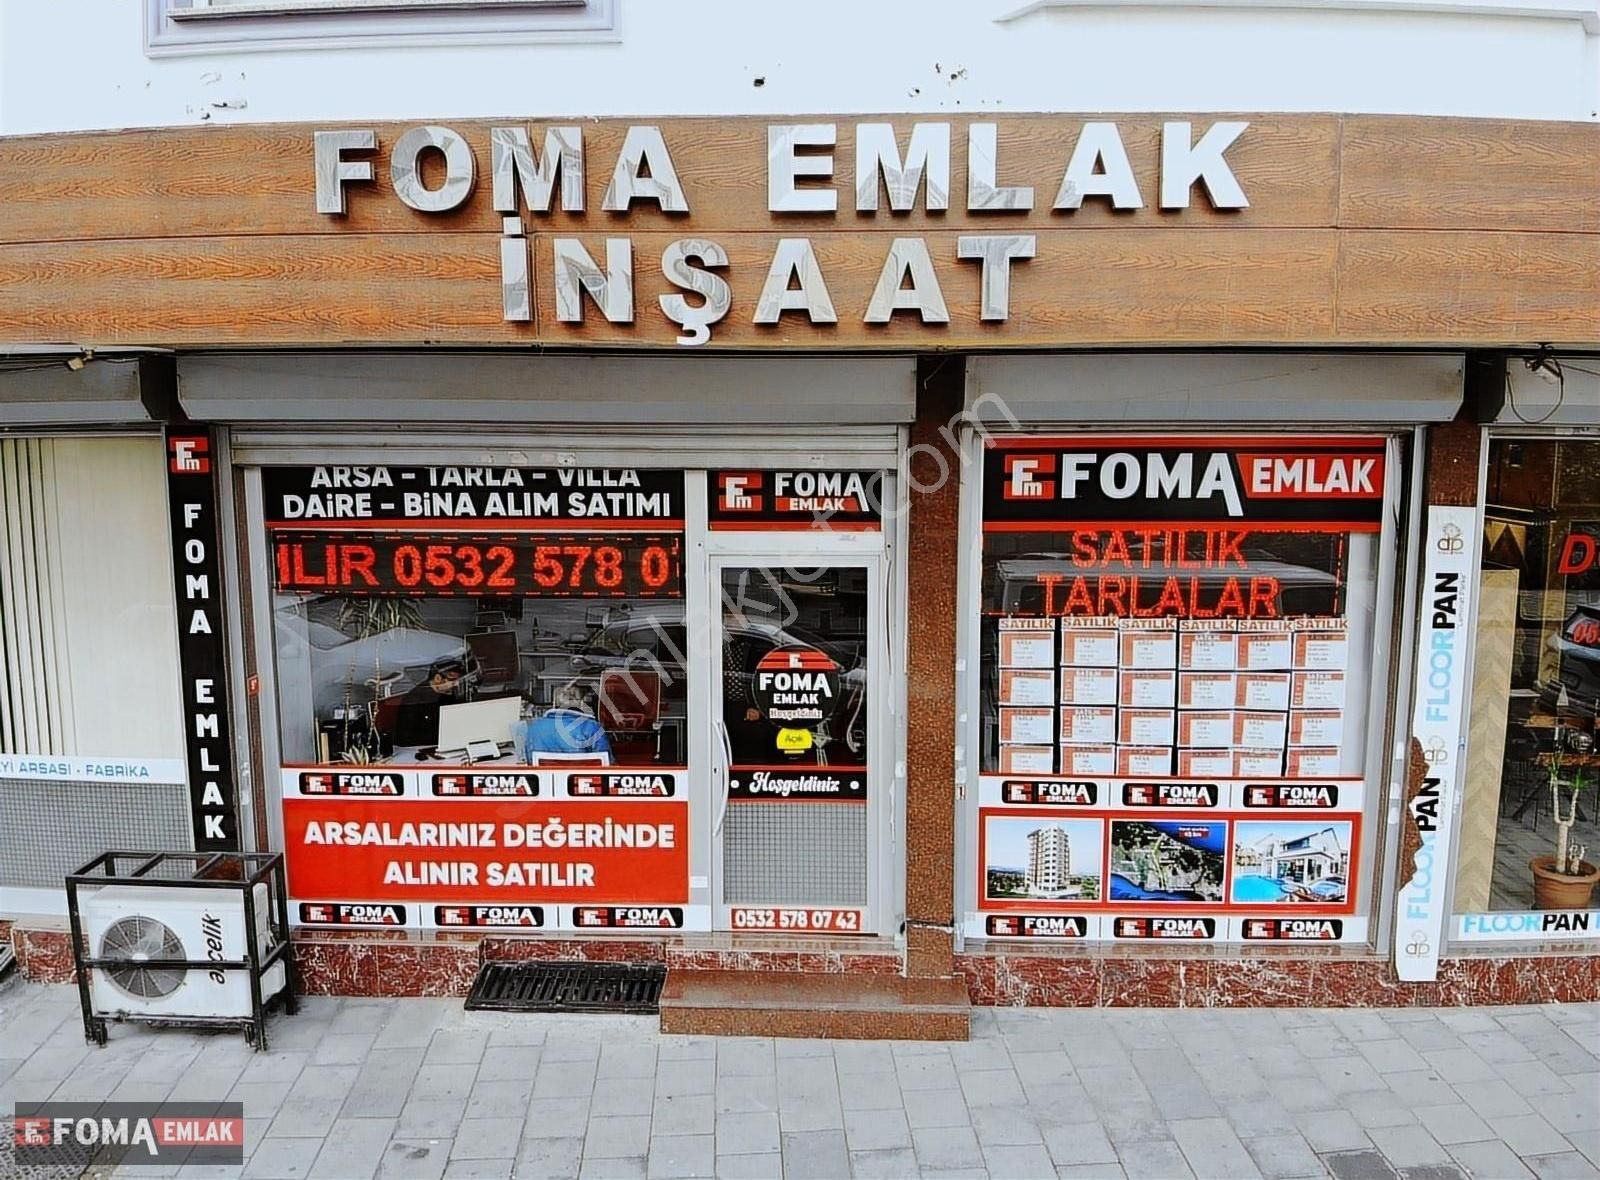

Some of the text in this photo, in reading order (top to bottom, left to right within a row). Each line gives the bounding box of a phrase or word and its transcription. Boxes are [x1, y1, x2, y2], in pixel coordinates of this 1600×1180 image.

[314, 121, 1251, 214] FOMA EMLAK
[500, 216, 1037, 346] İNŞAAT
[311, 466, 394, 488] ARSA
[428, 467, 524, 487] TARLA
[1061, 453, 1244, 517] FOMA
[1252, 459, 1376, 493] EMLAK
[775, 472, 870, 512] FOMA
[484, 492, 559, 517] ALIM
[568, 492, 671, 517] SATIMI
[789, 498, 846, 512] EMLAK
[1071, 530, 1249, 569] SATILIK
[395, 545, 516, 587] 0532
[533, 546, 624, 588] 578
[1037, 575, 1279, 618] TARLALAR
[1000, 618, 1053, 629] SATILIK
[1063, 617, 1118, 628] SATILIK
[1120, 619, 1175, 629] SATILIK
[1181, 620, 1235, 631] SATILIK
[1240, 621, 1293, 632] SATILIK
[1295, 619, 1348, 630] SATILIK
[1426, 572, 1460, 722] FLOORPAN
[184, 504, 226, 839] FOMA EMLAK
[760, 672, 832, 697] FOMA
[773, 693, 819, 704] EMLAK
[19, 762, 72, 775] ARSASI
[86, 762, 149, 777] FABRİKA
[338, 775, 398, 794] FOMA
[472, 776, 533, 795] FOMA
[608, 776, 668, 795] FOMA
[749, 771, 840, 797] Hoşgeldiniz
[1038, 783, 1091, 803] FOMA
[1159, 786, 1212, 805] FOMA
[1279, 787, 1332, 806] FOMA
[303, 816, 675, 849] ARSALARINIZ DEĞERİNDE
[383, 861, 595, 887] ALINIR SATILIR
[340, 906, 400, 924] FOMA
[476, 907, 537, 925] FOMA
[615, 908, 676, 926] FOMA
[735, 910, 857, 929] 0532 578 07 42
[1463, 912, 1589, 933] FLOORPAN
[1024, 917, 1080, 936] FOMA
[1152, 919, 1208, 937] FOMA
[1280, 921, 1336, 938] FOMA
